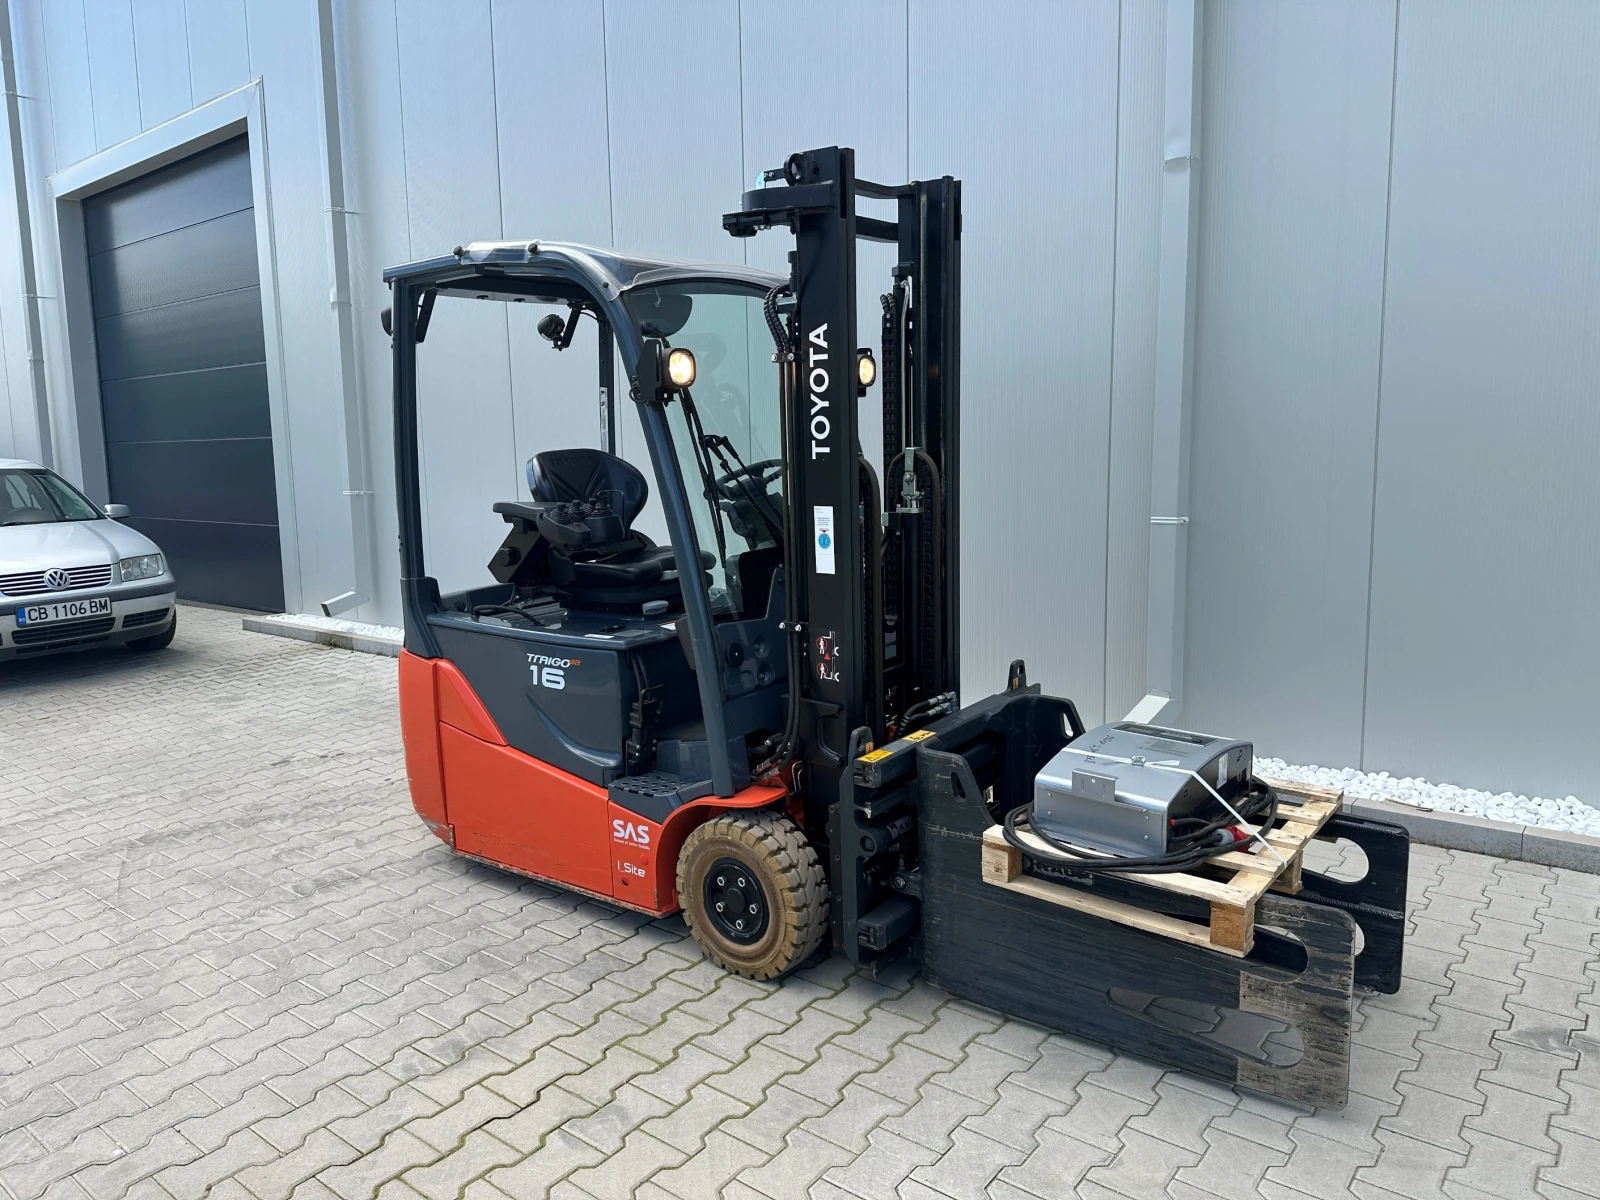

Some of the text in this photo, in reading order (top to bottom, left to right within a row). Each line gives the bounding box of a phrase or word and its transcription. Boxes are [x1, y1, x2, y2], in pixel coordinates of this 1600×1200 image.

[808, 322, 831, 460] TOYOTA
[28, 599, 109, 621] CB 1106 BM
[530, 664, 565, 690] 16
[612, 819, 650, 844] SAS
